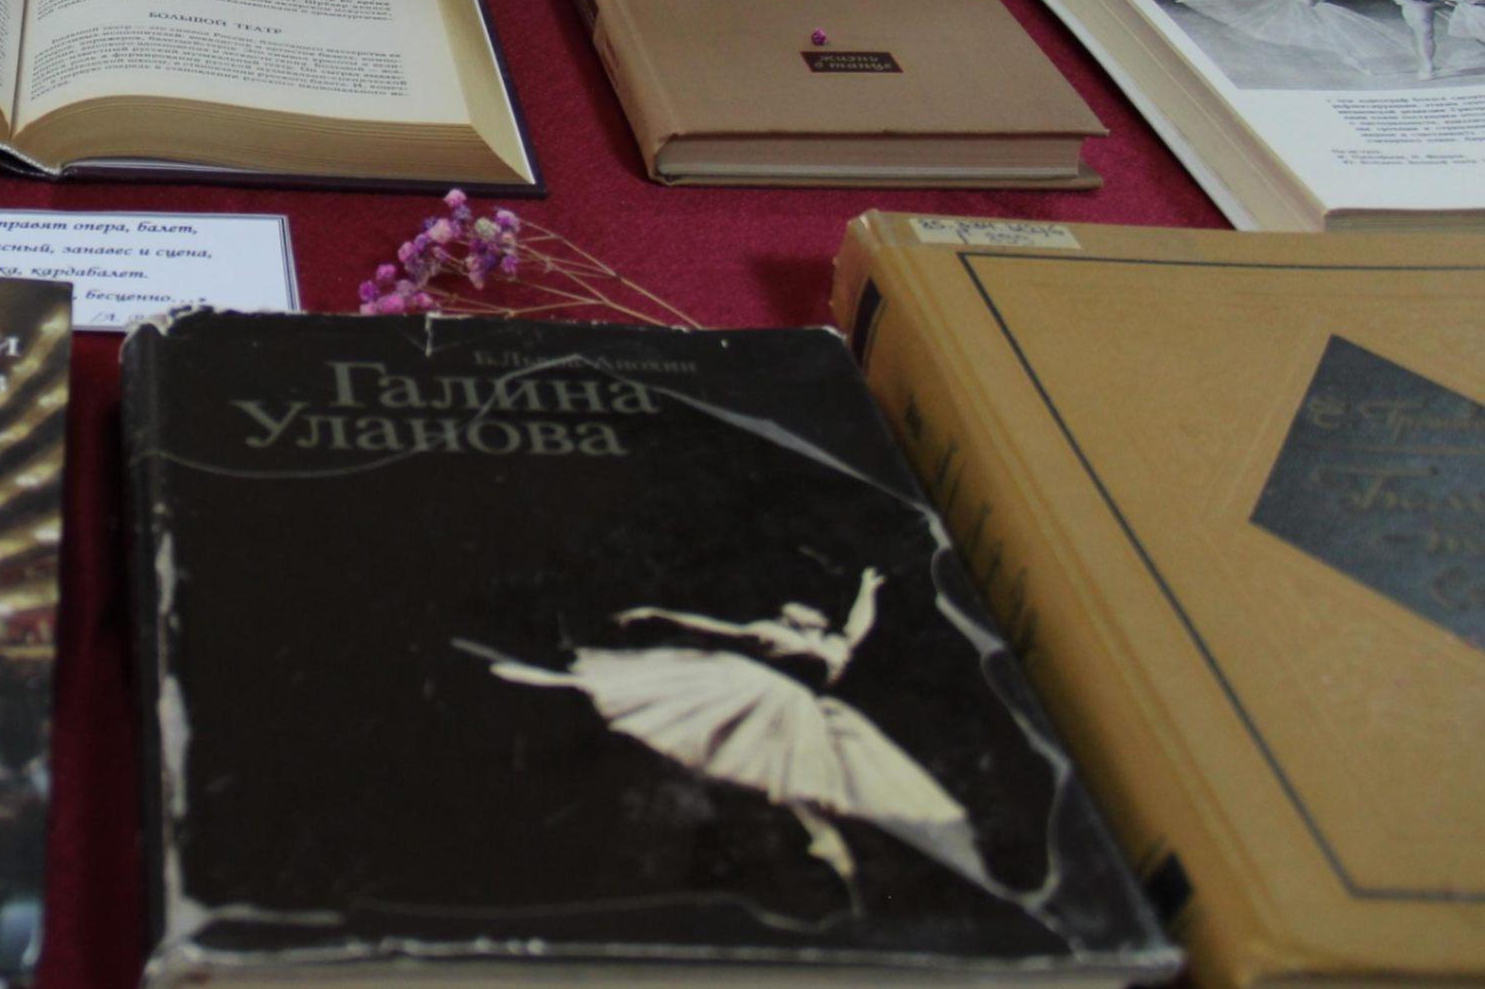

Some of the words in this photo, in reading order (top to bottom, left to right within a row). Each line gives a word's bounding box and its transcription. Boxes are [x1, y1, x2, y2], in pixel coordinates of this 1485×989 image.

[73, 222, 130, 235] опера,
[62, 246, 133, 257] занавес
[138, 248, 150, 257] и
[155, 248, 213, 259] сцена,
[325, 360, 662, 415] Галина
[230, 400, 629, 459] Уланова
